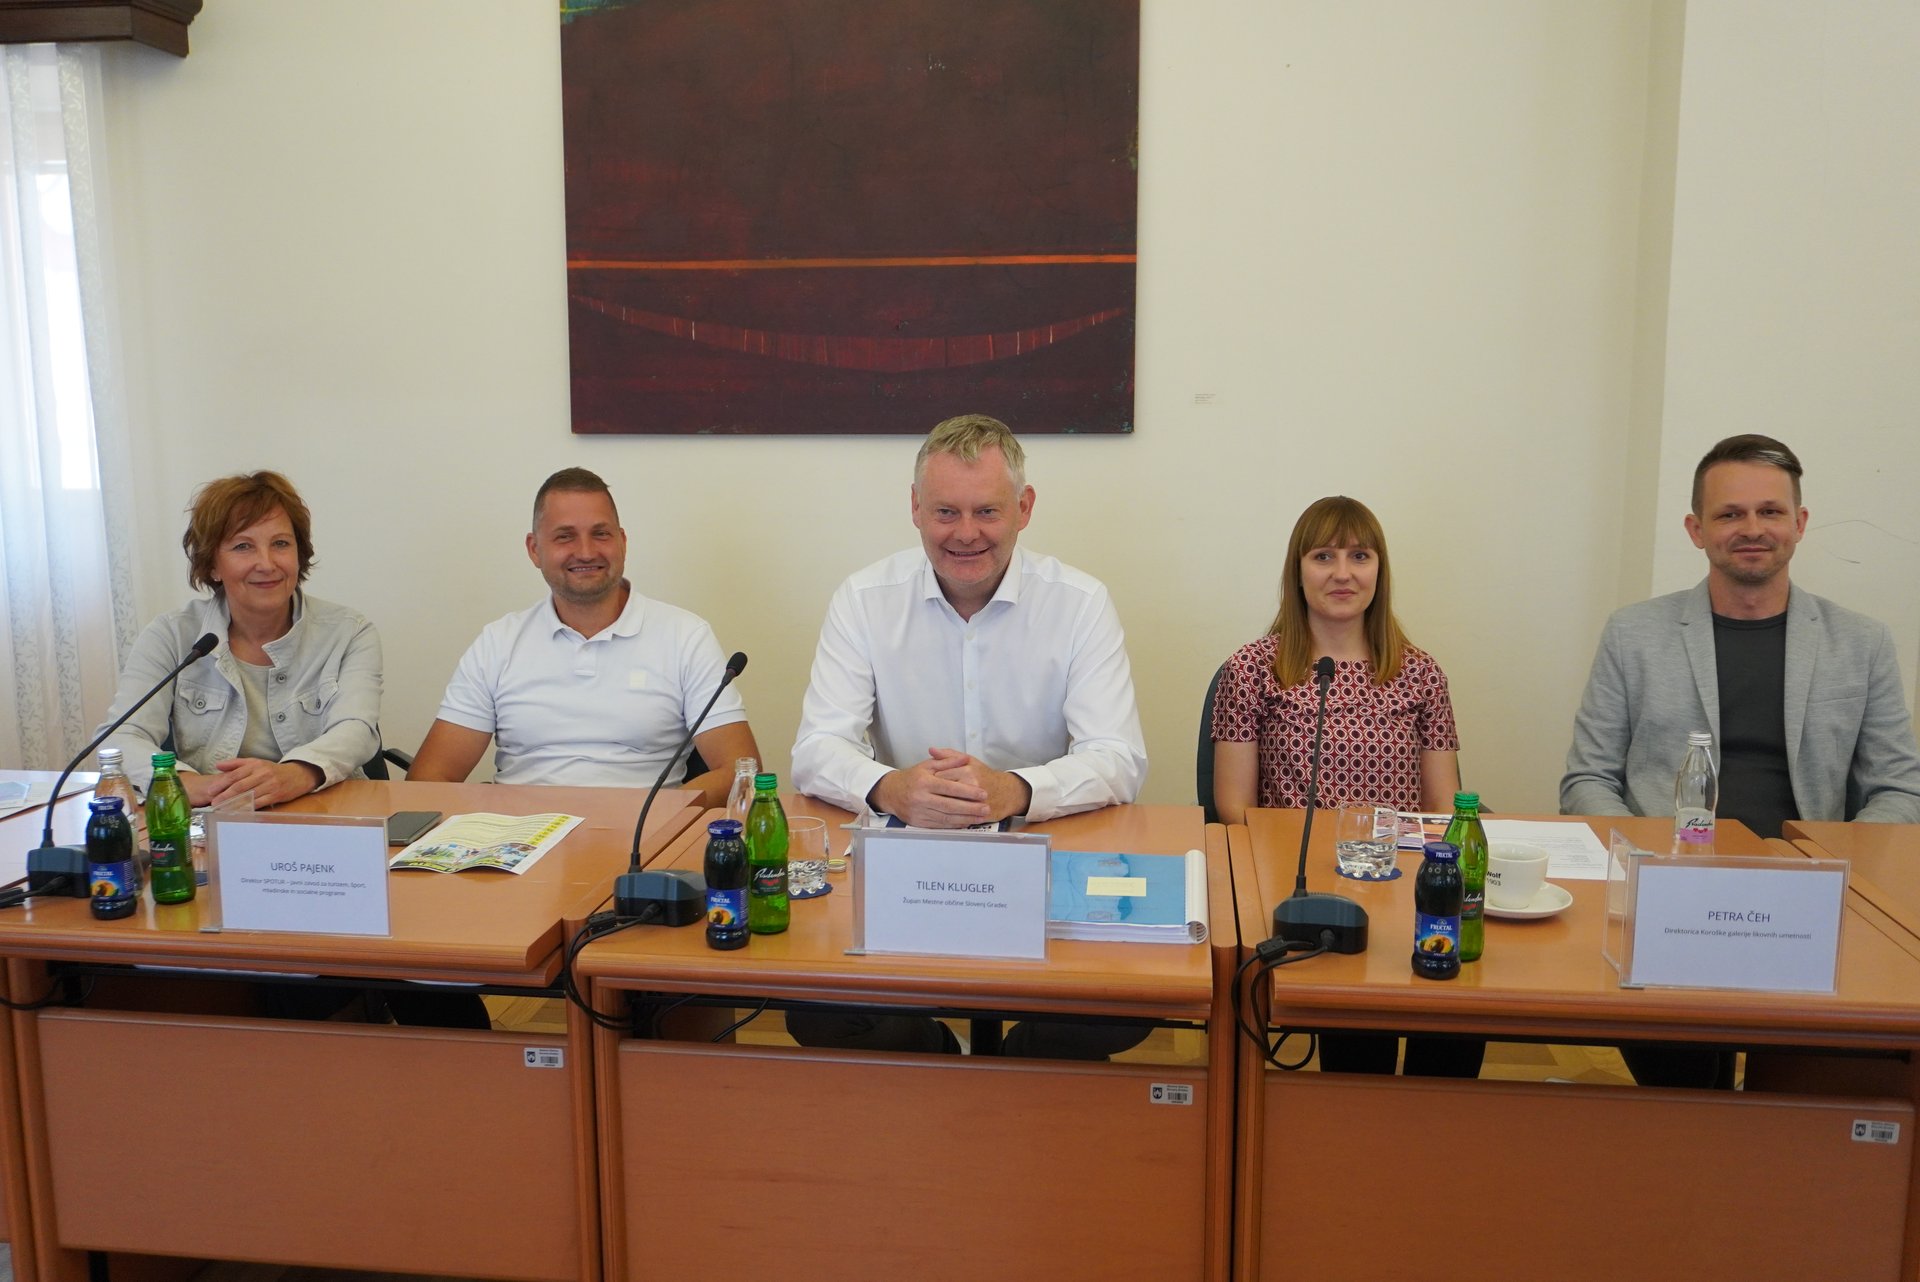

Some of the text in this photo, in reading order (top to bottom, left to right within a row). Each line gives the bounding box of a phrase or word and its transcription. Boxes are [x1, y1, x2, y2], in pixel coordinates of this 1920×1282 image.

[270, 861, 335, 874] UROŠ PAJENK
[916, 880, 995, 894] TILEN KLUGLER
[902, 896, 921, 905] Župan
[965, 900, 986, 908] Slovenj
[1707, 910, 1771, 923] PETRA ČEH
[1664, 927, 1812, 940] Direktorica Koroške galerije likovnih umetnosti
